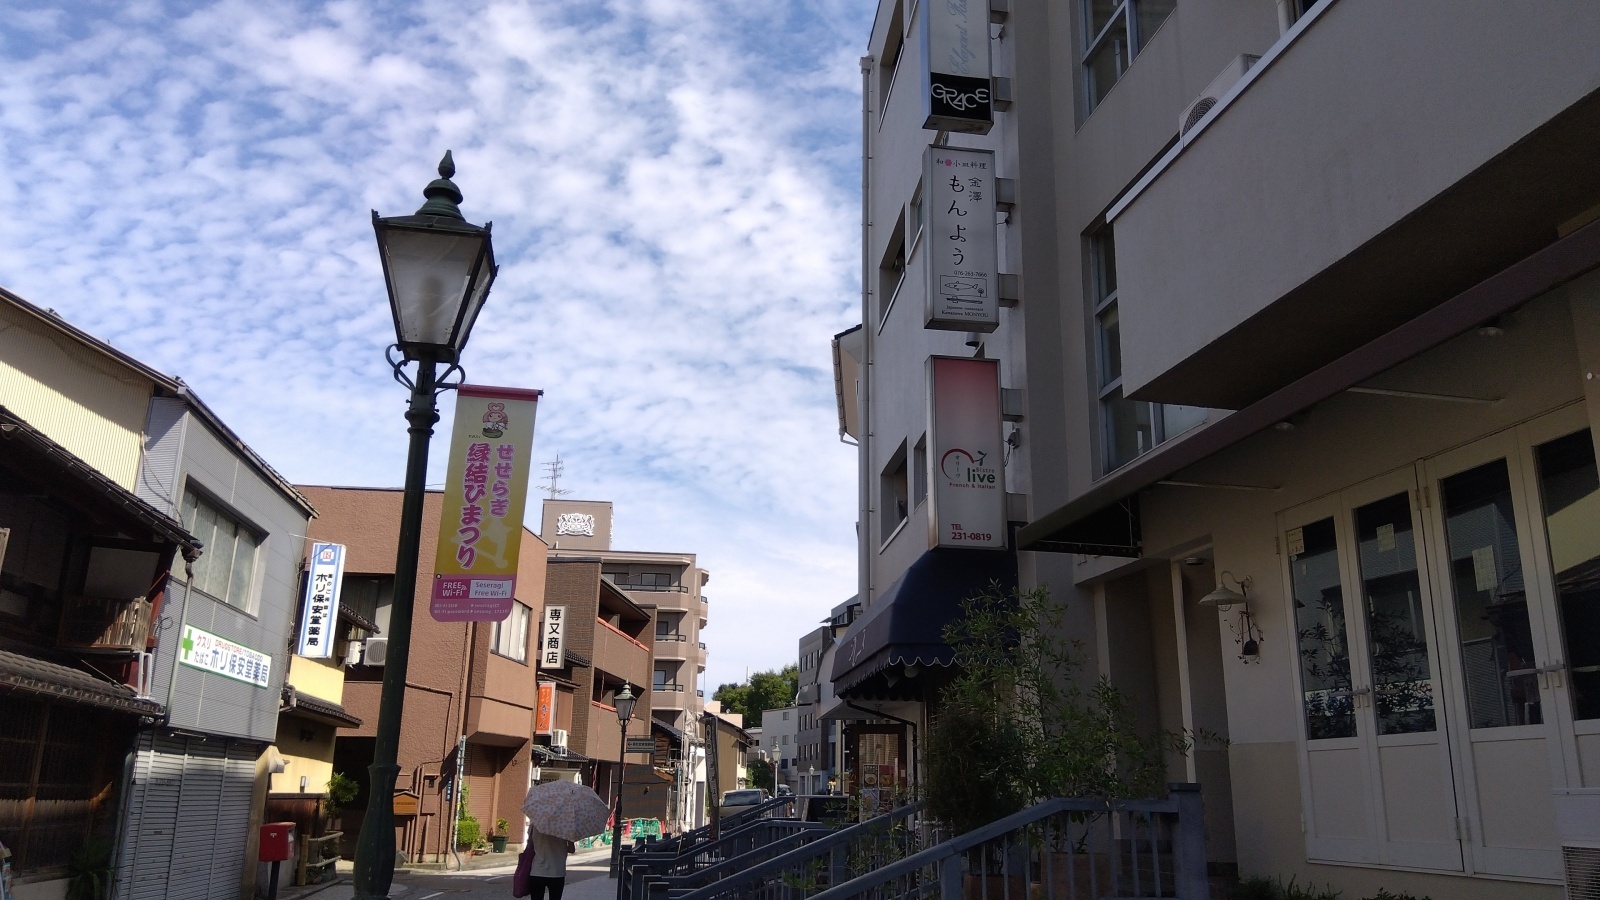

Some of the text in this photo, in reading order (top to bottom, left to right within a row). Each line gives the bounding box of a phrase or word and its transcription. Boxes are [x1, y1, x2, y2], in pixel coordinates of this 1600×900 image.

[947, 174, 968, 266] もんよう
[490, 444, 515, 519] せせらぎ
[456, 442, 492, 570] 縁結びまつり
[951, 532, 992, 541] 231-0819
[442, 581, 462, 589] FREE
[442, 589, 463, 597] Wi-Fi
[475, 582, 504, 590] Seseragi
[306, 573, 328, 647] ホリ保安堂薬局
[196, 635, 212, 650] クスリ
[545, 608, 562, 664] 専又商店
[194, 650, 209, 666] たばこ
[209, 648, 269, 684] ホリ保安堂薬局
